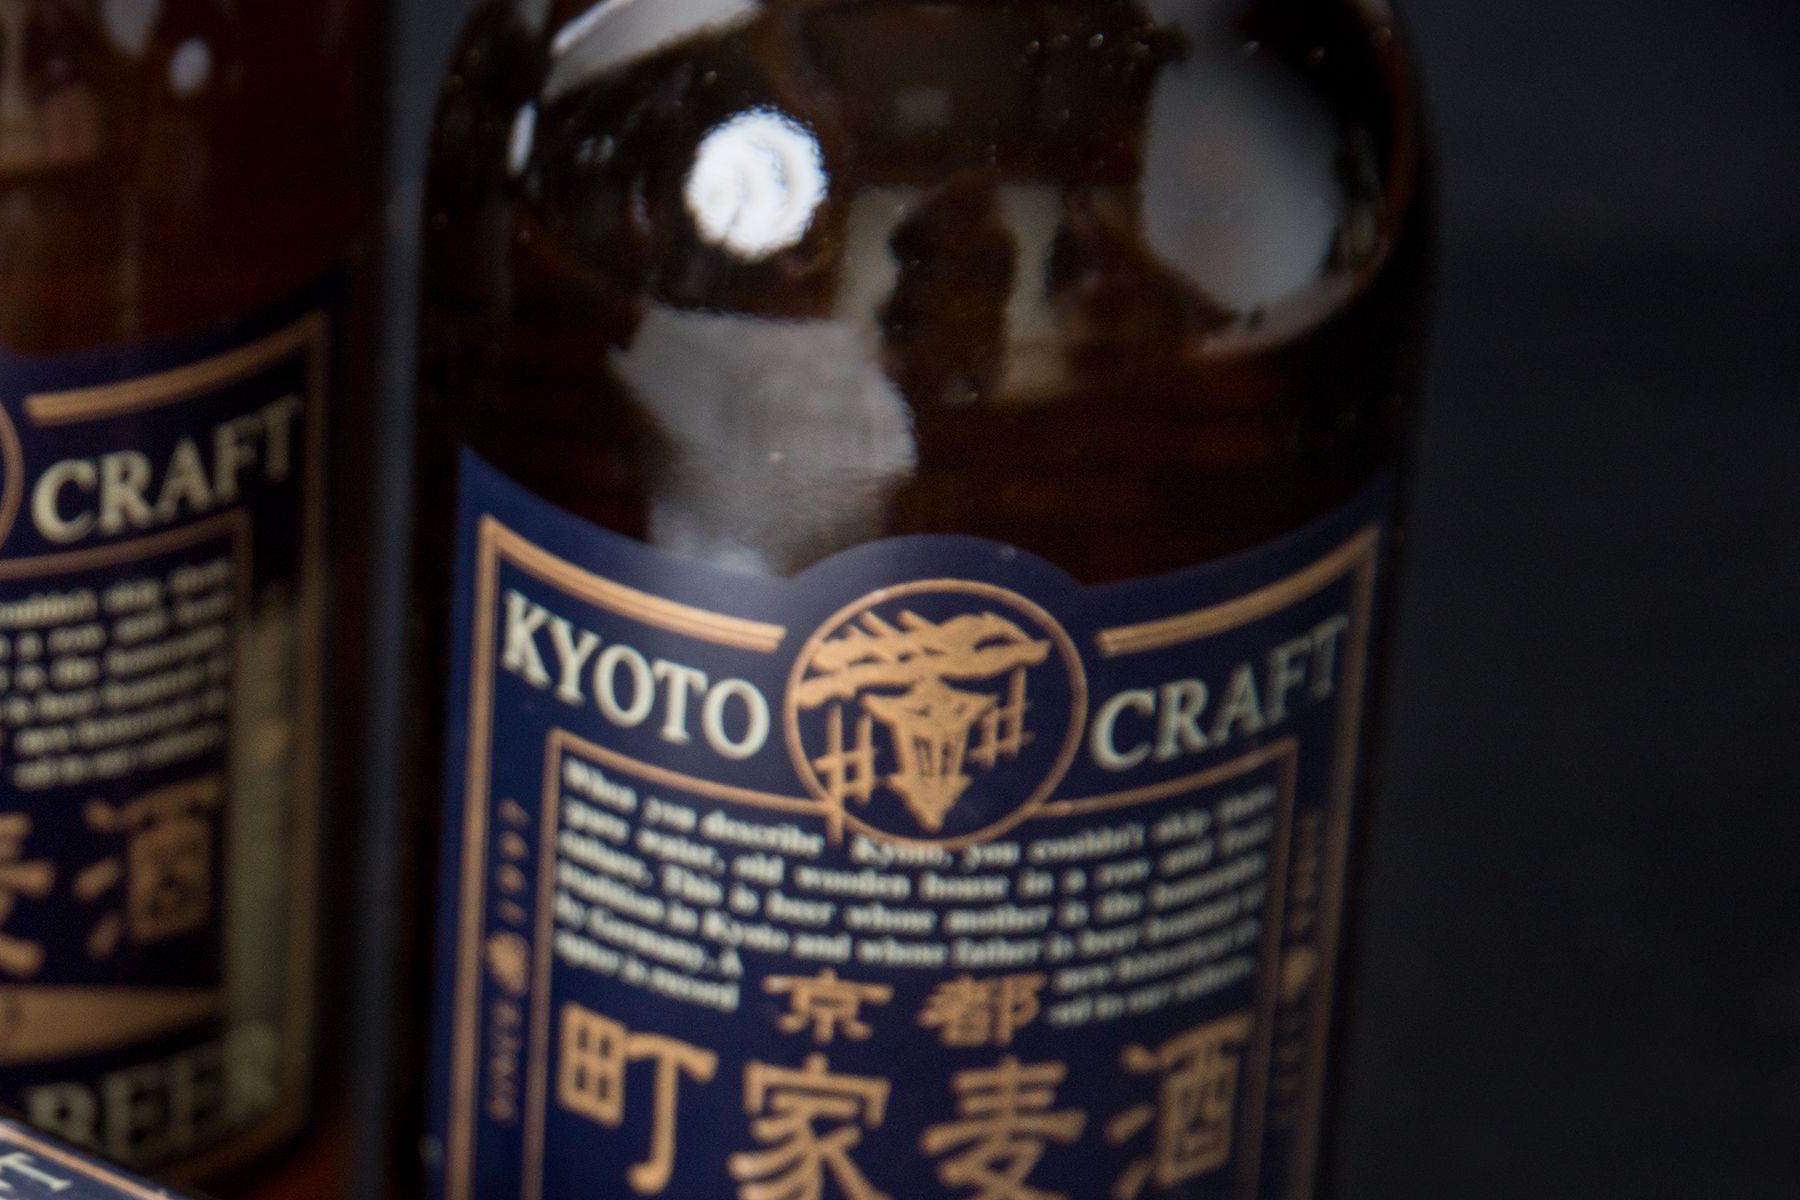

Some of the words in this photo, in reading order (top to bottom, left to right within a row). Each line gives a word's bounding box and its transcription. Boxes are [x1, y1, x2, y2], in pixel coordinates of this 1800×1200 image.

[31, 398, 301, 543] CRAFT
[500, 588, 770, 761] KYOTO
[1092, 613, 1350, 772] CRAFT
[761, 970, 1048, 1048] 京都
